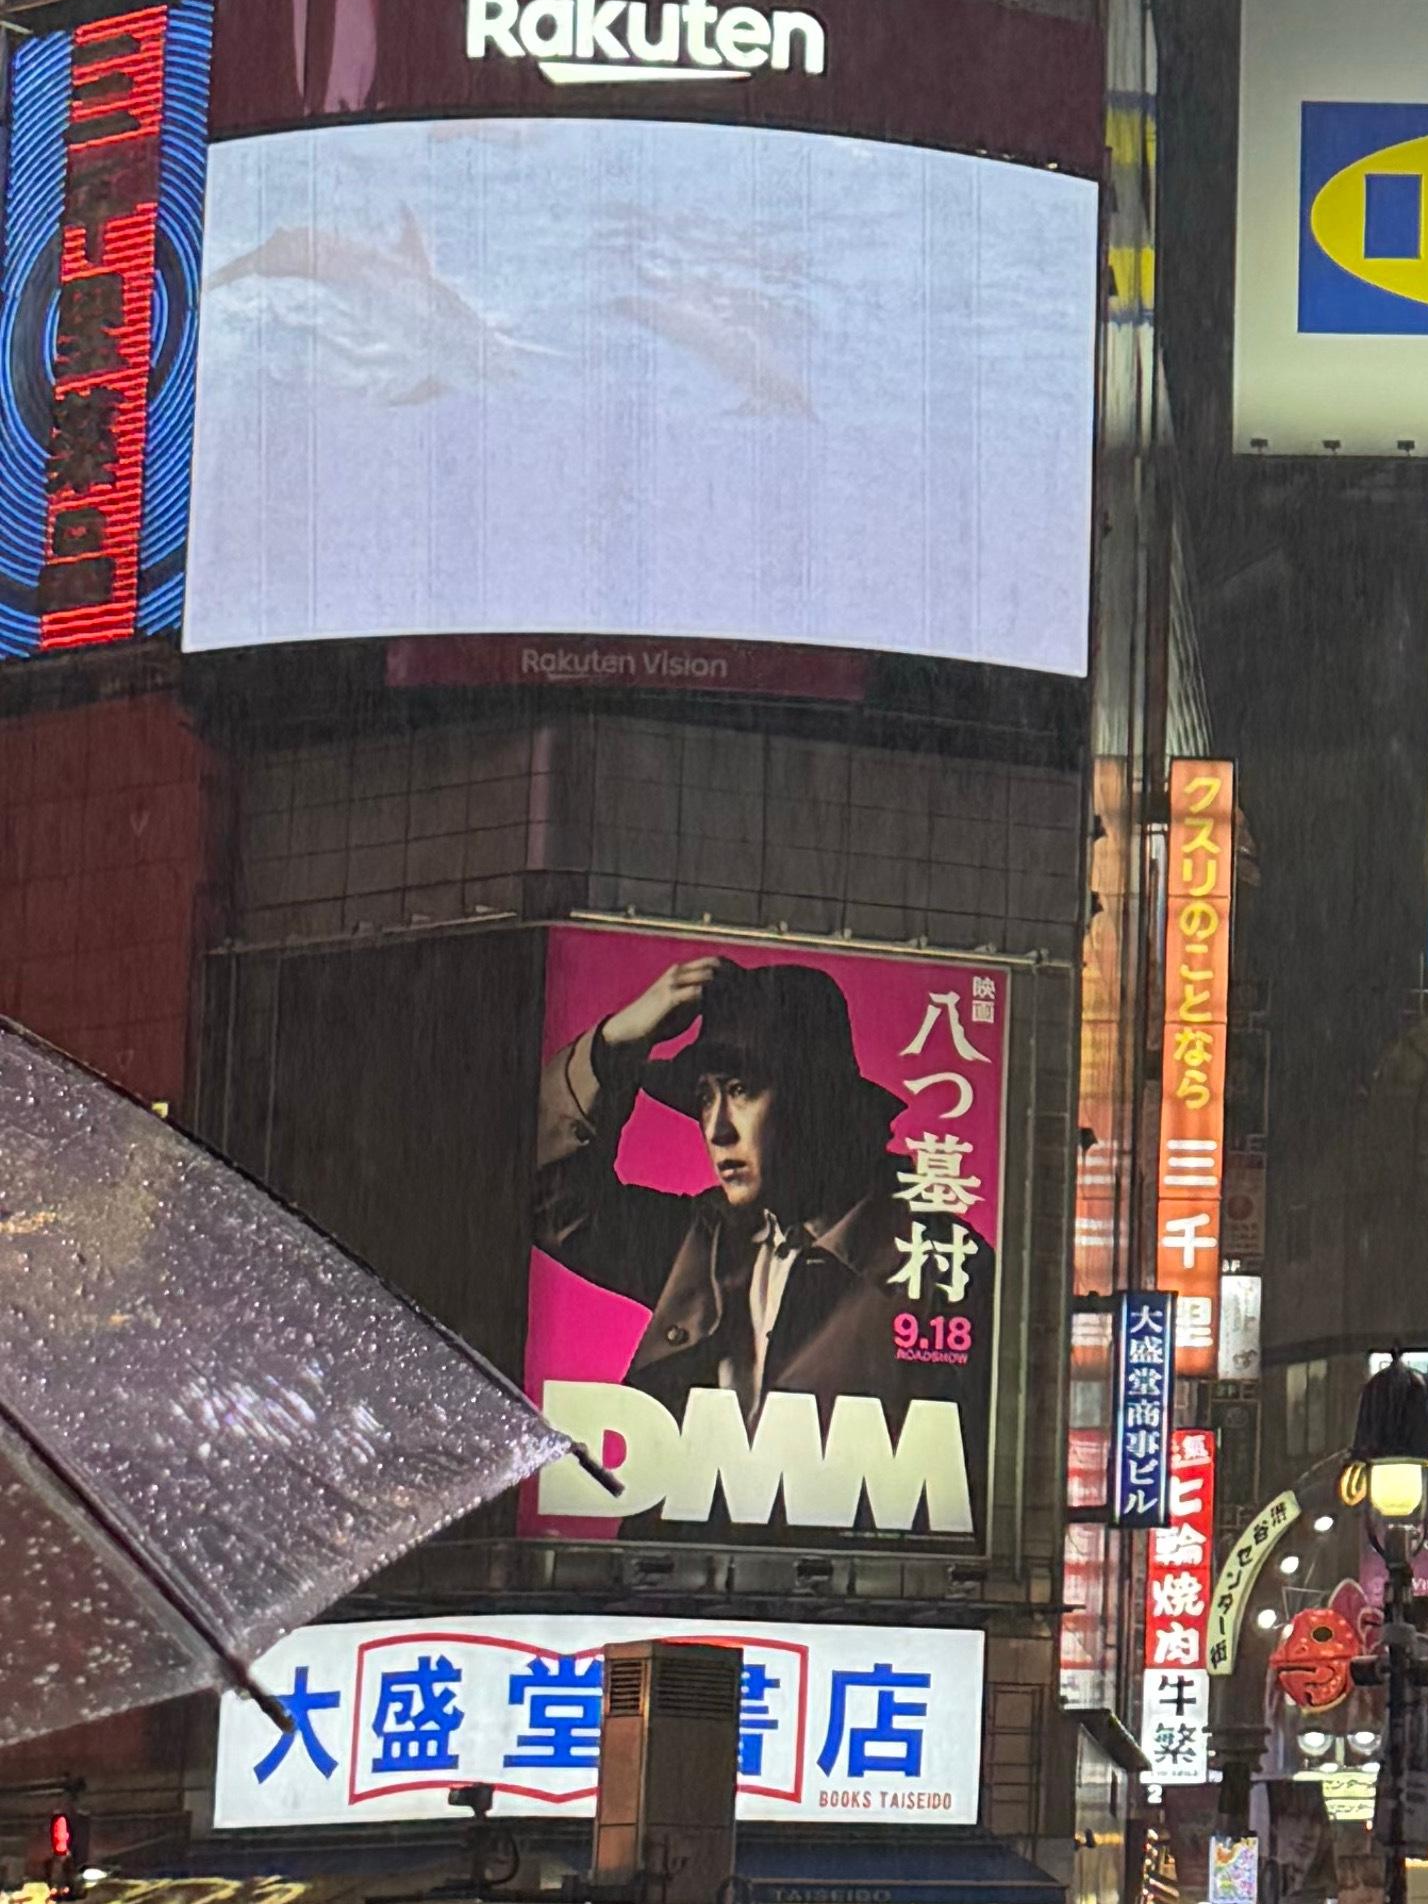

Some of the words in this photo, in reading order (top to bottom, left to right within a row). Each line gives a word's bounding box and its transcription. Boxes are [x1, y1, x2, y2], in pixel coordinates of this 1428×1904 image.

[521, 648, 636, 675] Rakuten
[643, 650, 728, 677] Vision
[1172, 776, 1223, 1111] クスリのことなら
[887, 990, 993, 1303] 八つ墓村
[893, 1312, 973, 1352] 9.18
[537, 1379, 976, 1534] DMM
[1125, 1304, 1165, 1517] 大盛堂商事ビル
[818, 1789, 872, 1809] BOOKS
[879, 1790, 952, 1810] TAISEIDO
